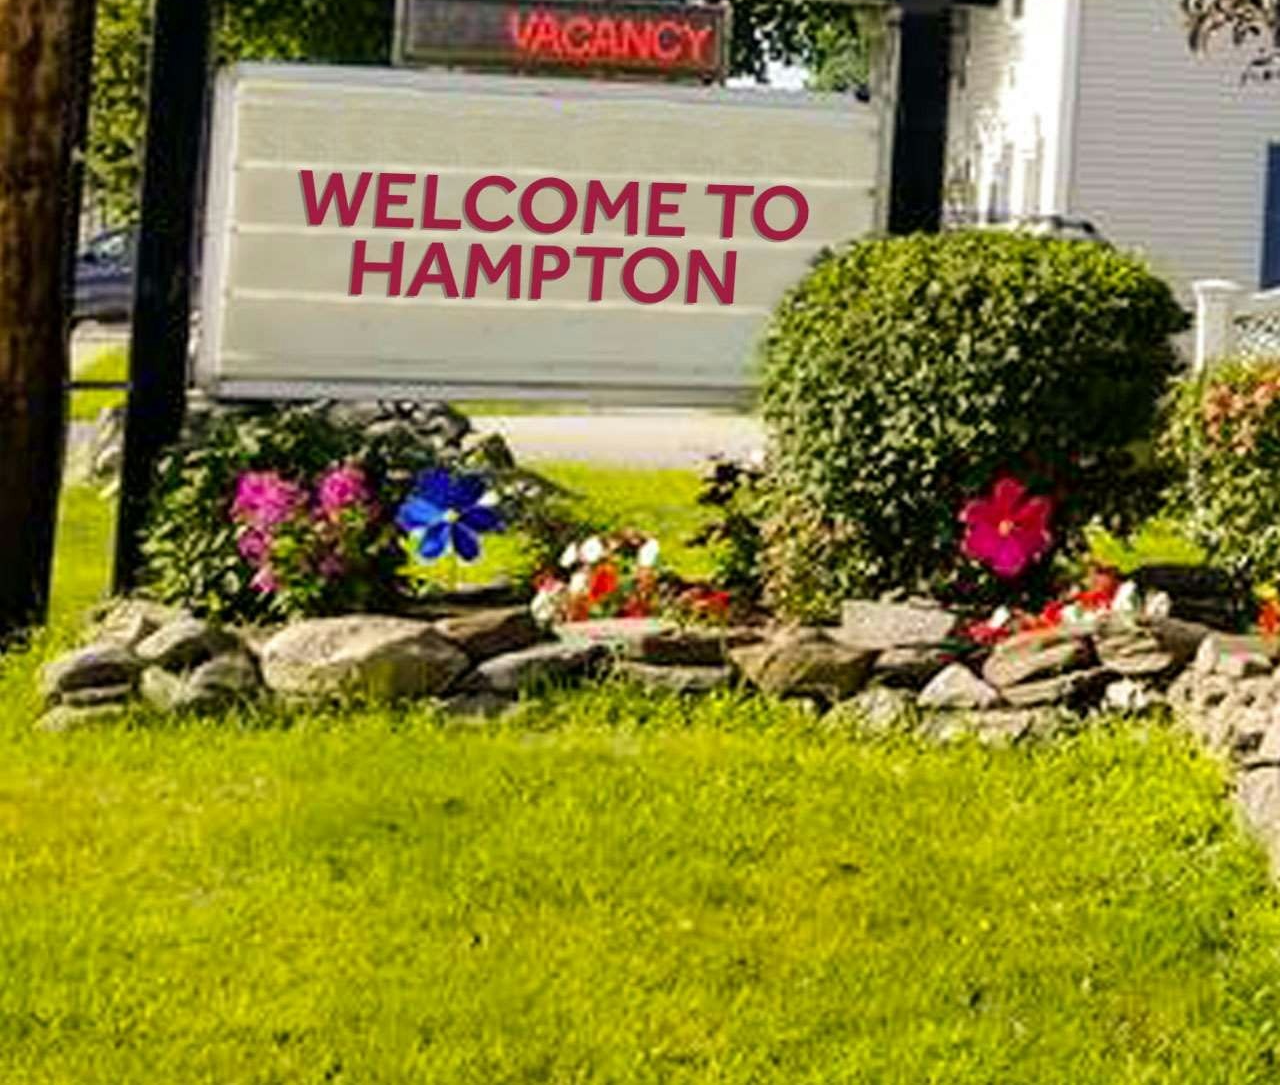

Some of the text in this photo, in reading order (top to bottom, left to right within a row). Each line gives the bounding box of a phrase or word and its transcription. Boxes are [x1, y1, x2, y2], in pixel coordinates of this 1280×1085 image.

[508, 9, 714, 62] VACANCY
[299, 169, 809, 243] WELCOME TO
[348, 240, 738, 306] HAMPTON
